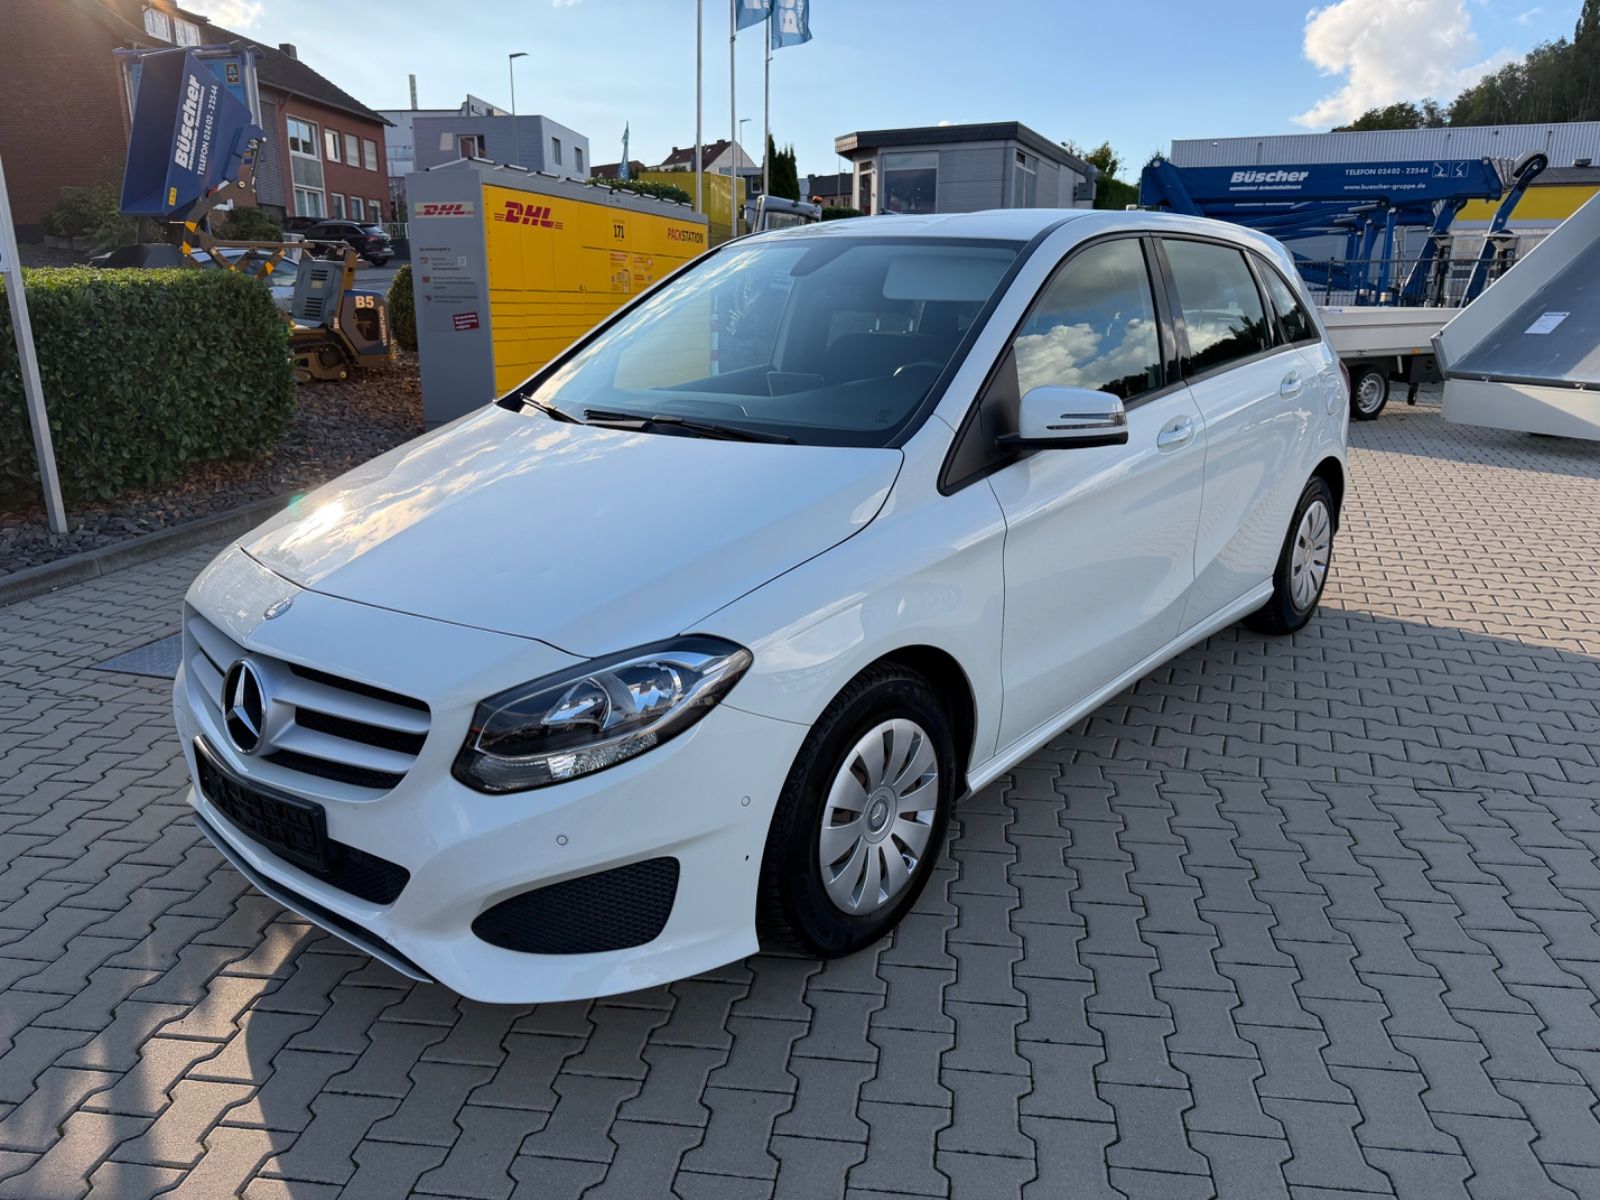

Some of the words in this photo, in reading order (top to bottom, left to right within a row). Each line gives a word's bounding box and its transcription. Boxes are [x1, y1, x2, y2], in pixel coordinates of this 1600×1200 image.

[208, 84, 218, 111] 22544
[175, 74, 201, 169] Büscher
[203, 115, 214, 141] 02402
[197, 141, 210, 175] TELEFON
[1230, 170, 1309, 184] Büscher
[1345, 168, 1376, 176] TELEFON
[1344, 182, 1426, 190] www.buescher-gruppe.de
[423, 204, 466, 216] DHL
[505, 201, 554, 229] DHL
[613, 224, 625, 239] 171
[667, 227, 704, 244] PACKSTATION
[355, 295, 374, 308] B5
